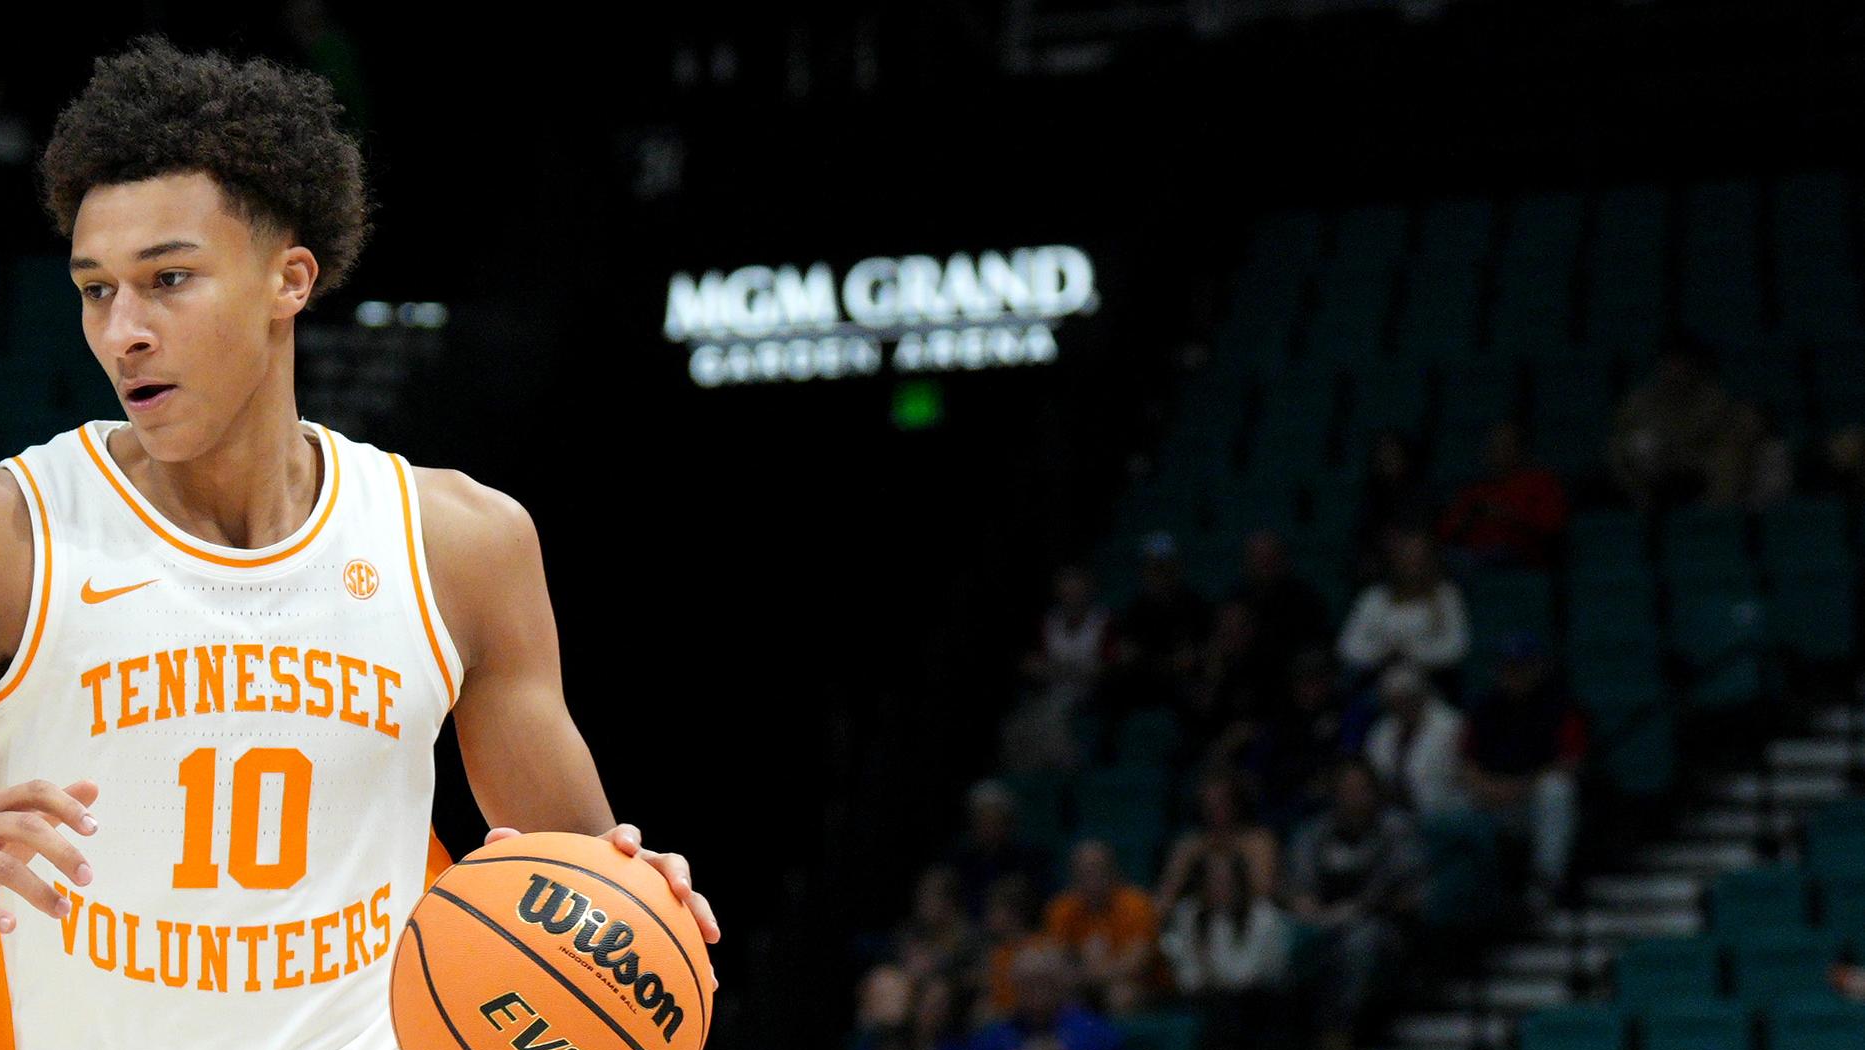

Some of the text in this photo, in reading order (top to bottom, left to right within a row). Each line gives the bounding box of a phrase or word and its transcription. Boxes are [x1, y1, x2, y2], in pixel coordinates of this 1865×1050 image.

[664, 245, 1095, 340] MGM GRAND
[346, 562, 375, 596] SEC
[81, 644, 402, 739] TENNESSEE
[172, 747, 313, 889] 10
[54, 882, 391, 993] VOLUNTEERS
[516, 873, 684, 1044] Wilson
[558, 946, 638, 1015] INDOOR GAME BALL
